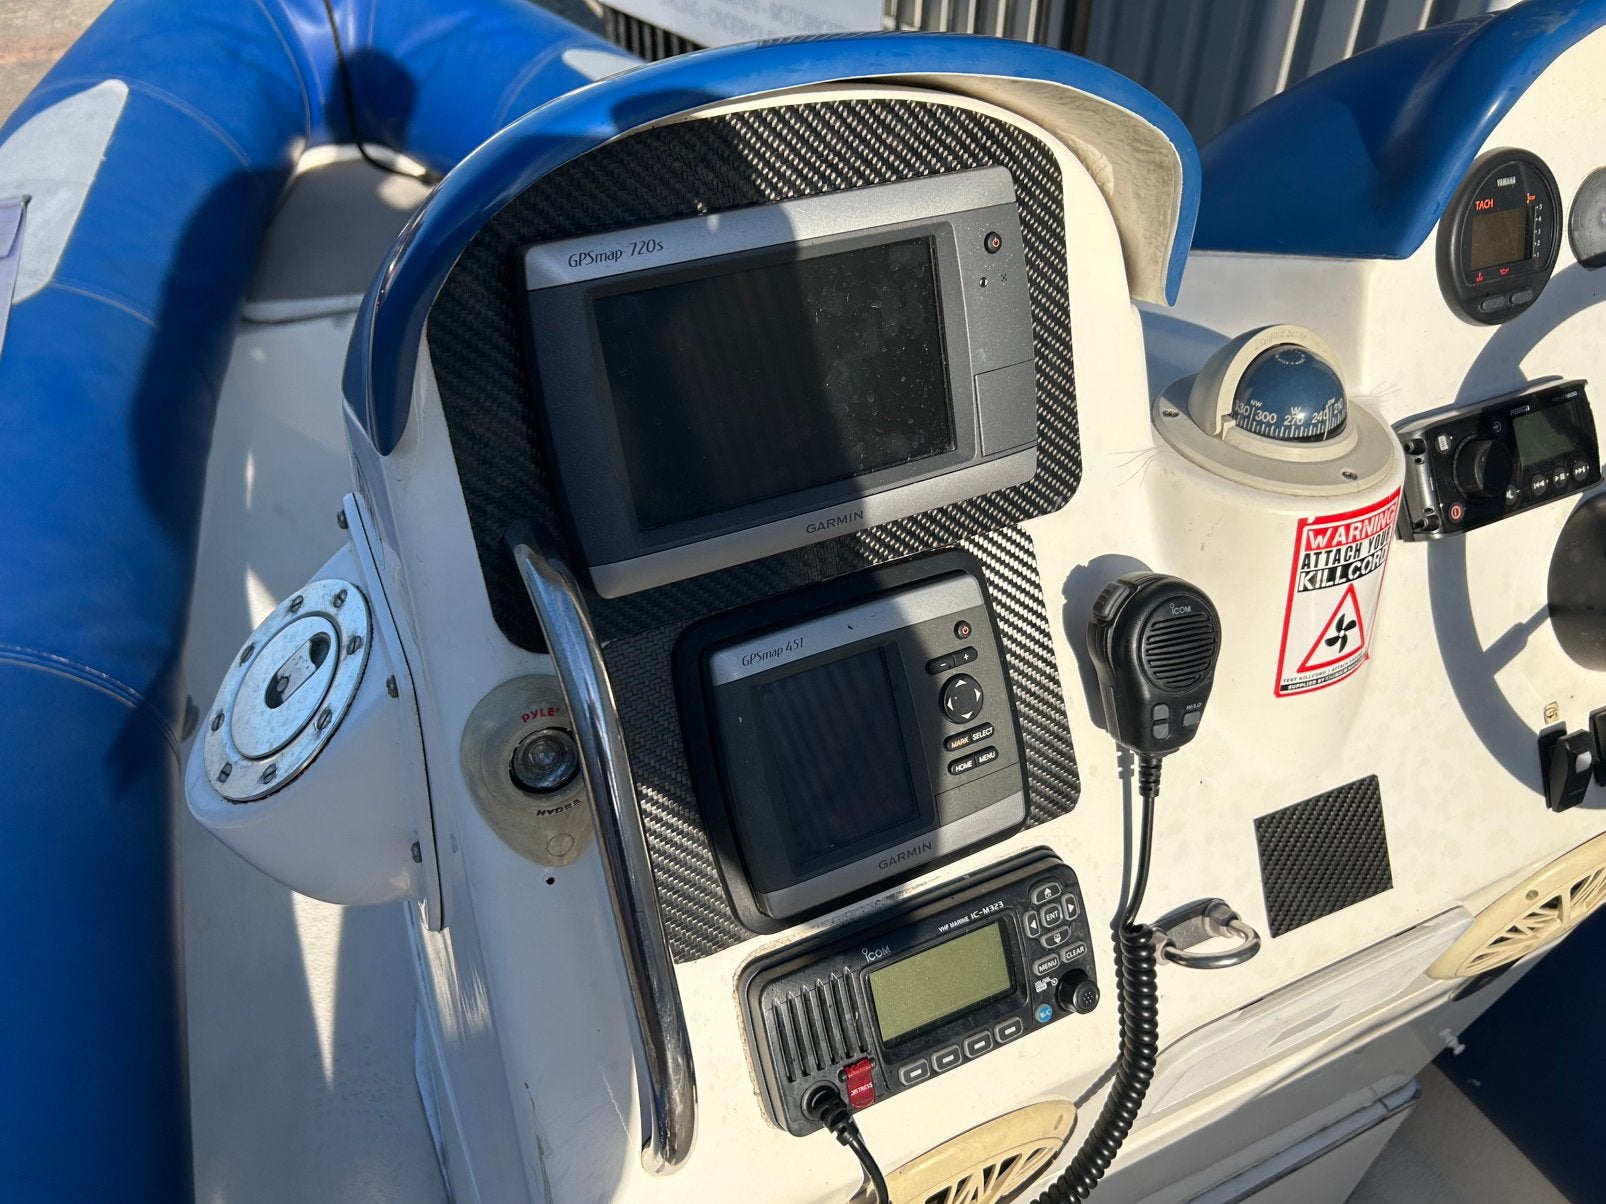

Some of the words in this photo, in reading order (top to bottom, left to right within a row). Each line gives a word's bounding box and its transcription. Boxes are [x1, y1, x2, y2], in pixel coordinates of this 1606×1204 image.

[1497, 176, 1516, 187] YAMAHA
[1475, 199, 1494, 211] TACH
[568, 249, 623, 268] GPSmap
[630, 238, 664, 257] 720s
[1250, 399, 1263, 408] NW
[1290, 406, 1302, 415] W
[1255, 410, 1277, 423] 300
[1283, 413, 1304, 426] 270
[1311, 407, 1329, 423] 240
[806, 510, 864, 534] GARMIN
[1301, 542, 1363, 570] ATTACH
[742, 647, 783, 667] GPSmap
[785, 637, 804, 652] 451
[521, 707, 555, 723] PYLE
[951, 737, 969, 749] MARK
[972, 727, 993, 741] SELECT
[955, 760, 973, 772] HOME
[979, 751, 996, 763] MENU
[878, 842, 932, 869] GARMIN
[938, 924, 949, 933] VHF
[950, 916, 970, 928] MARINE
[970, 901, 1004, 920] IC-M323
[1046, 911, 1059, 921] ENT
[1066, 945, 1085, 959] CLEAR
[1038, 959, 1058, 972] MENU
